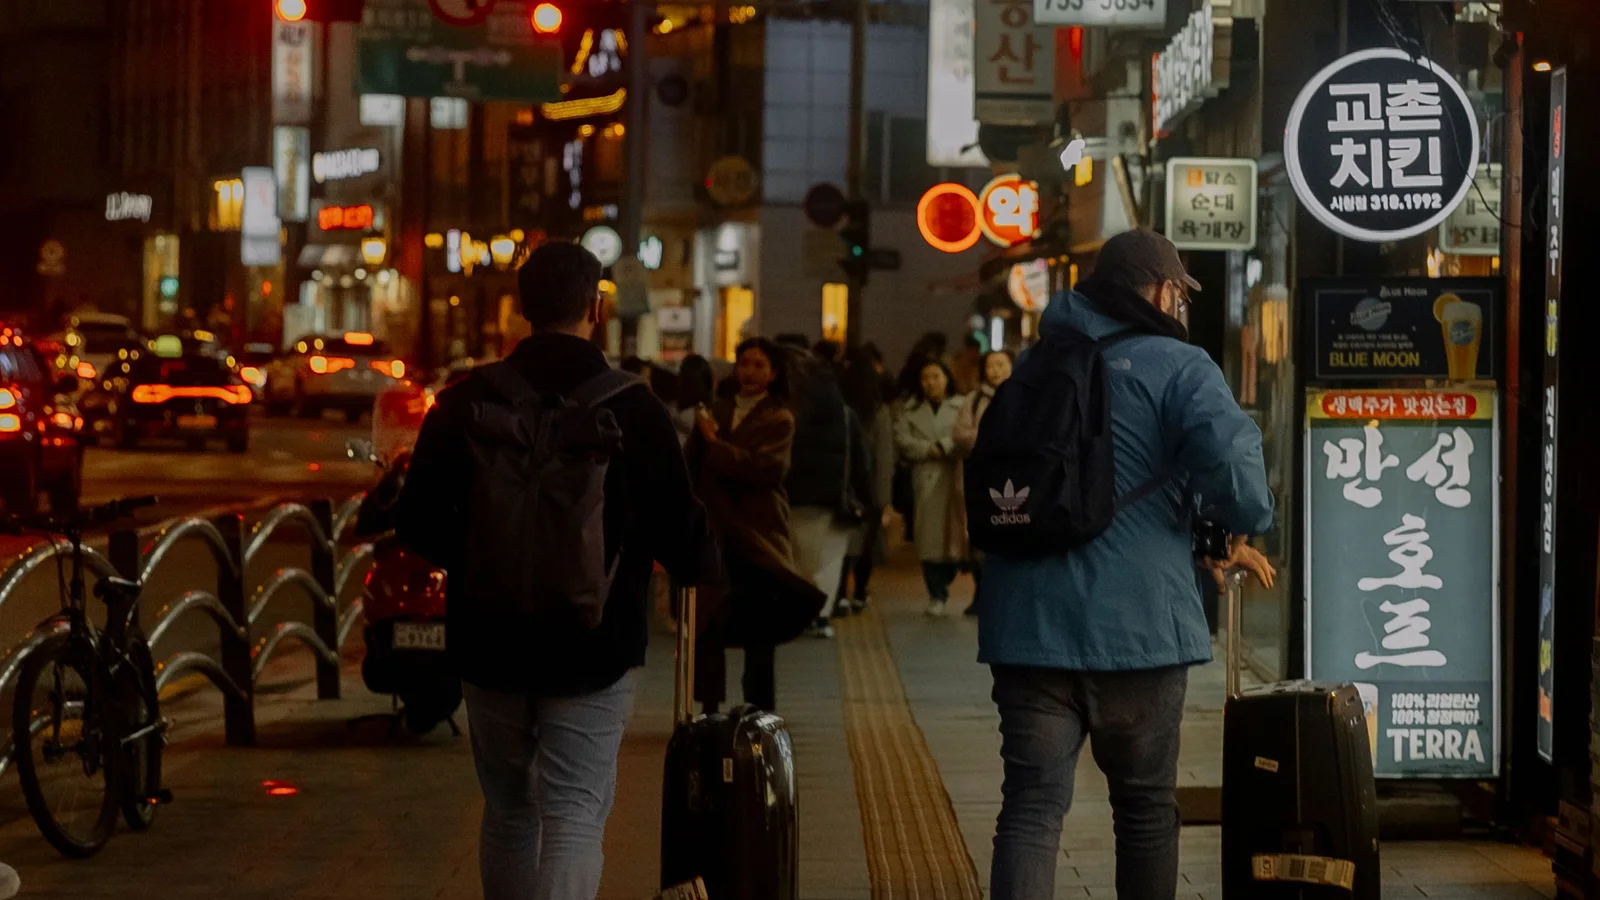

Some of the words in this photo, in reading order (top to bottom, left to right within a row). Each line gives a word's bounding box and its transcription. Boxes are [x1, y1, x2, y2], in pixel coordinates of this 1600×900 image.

[1327, 79, 1442, 132] 교촌
[1330, 137, 1443, 189] 치킨
[987, 184, 1039, 236] 약
[1191, 193, 1234, 211] 순대
[1178, 219, 1247, 240] 육개장
[1329, 352, 1368, 368] BLUE
[1373, 352, 1420, 368] MOON
[1333, 395, 1396, 415] 생맥주가
[1402, 394, 1467, 415] 맛있는집
[1323, 426, 1474, 508] 만선
[990, 512, 1032, 526] adidas
[1391, 693, 1425, 709] 100%
[1391, 709, 1425, 725] 100%
[1386, 729, 1485, 764] TERRA
